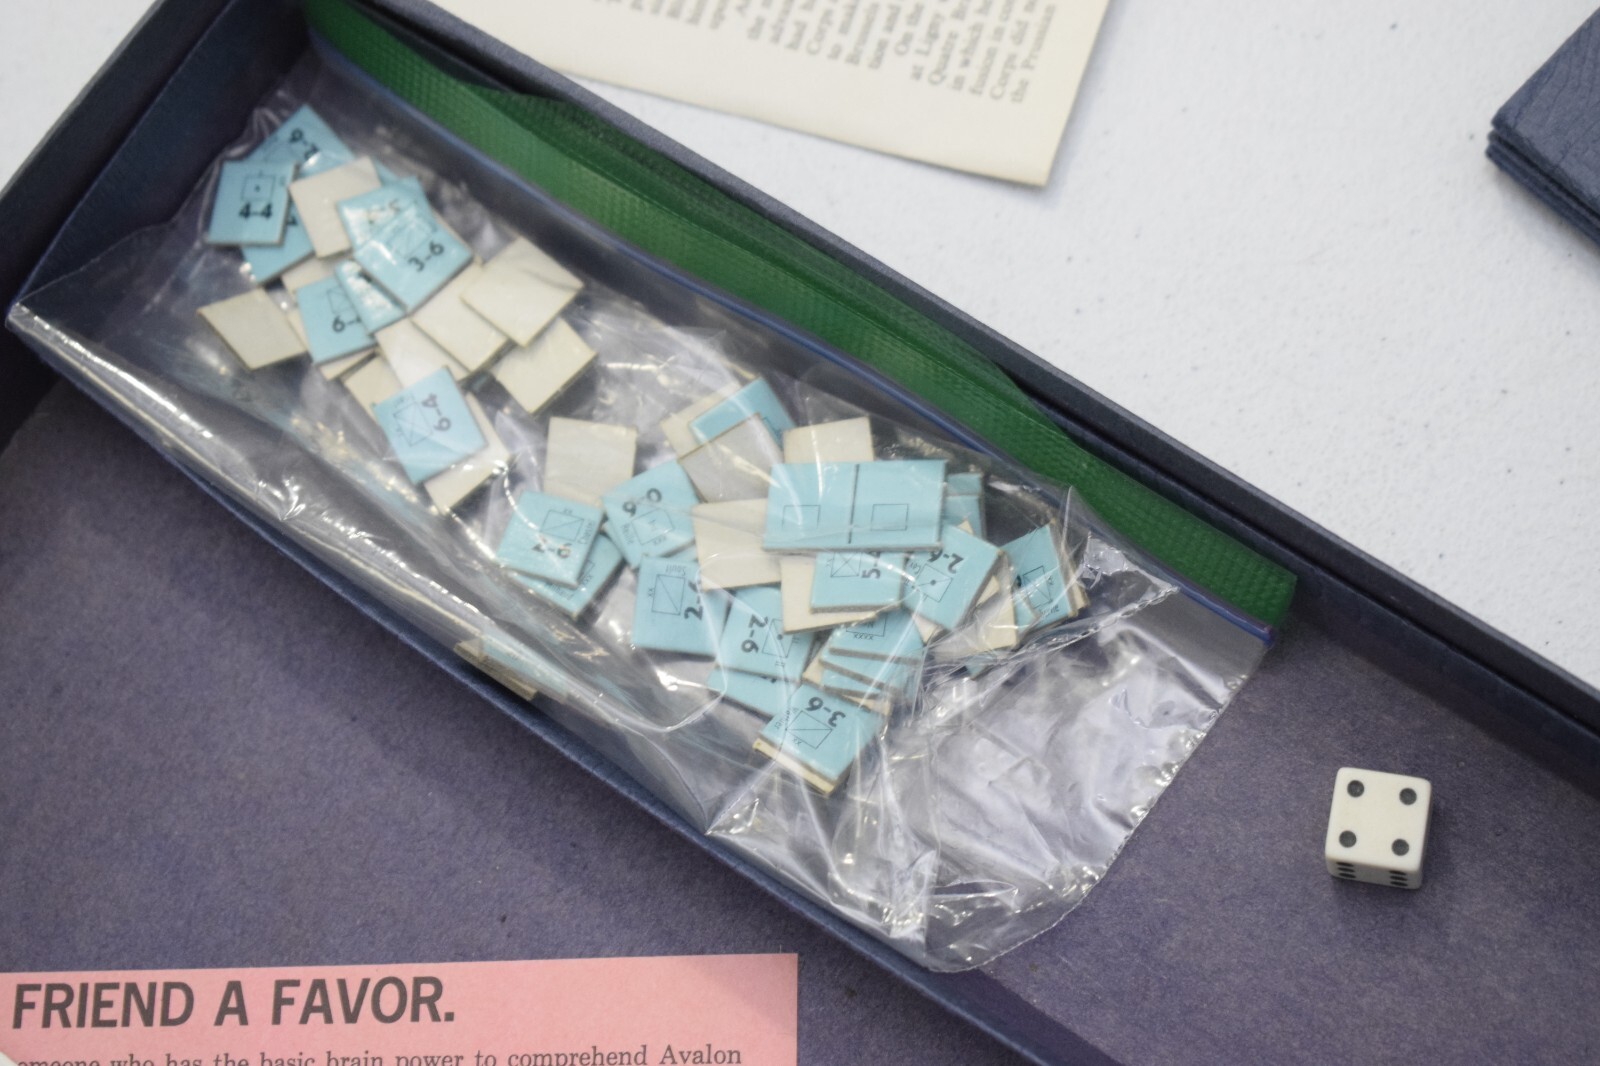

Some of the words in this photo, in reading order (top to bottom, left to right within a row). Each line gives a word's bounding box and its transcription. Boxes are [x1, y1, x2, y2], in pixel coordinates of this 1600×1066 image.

[238, 202, 274, 219] 4-4
[407, 240, 445, 272] 3-6
[331, 315, 363, 333] 6-
[421, 392, 452, 432] 6-4
[741, 613, 769, 655] 2-6
[804, 696, 847, 729] 3-6
[12, 981, 195, 1029] FRIEND
[213, 980, 249, 1026] A
[271, 976, 455, 1025] FAVOR.
[260, 1052, 316, 1066] basic
[326, 1050, 384, 1066] brain
[395, 1053, 465, 1066] power
[474, 1049, 498, 1066] to
[507, 1044, 647, 1066] comprehend
[659, 1044, 742, 1065] Avalon
